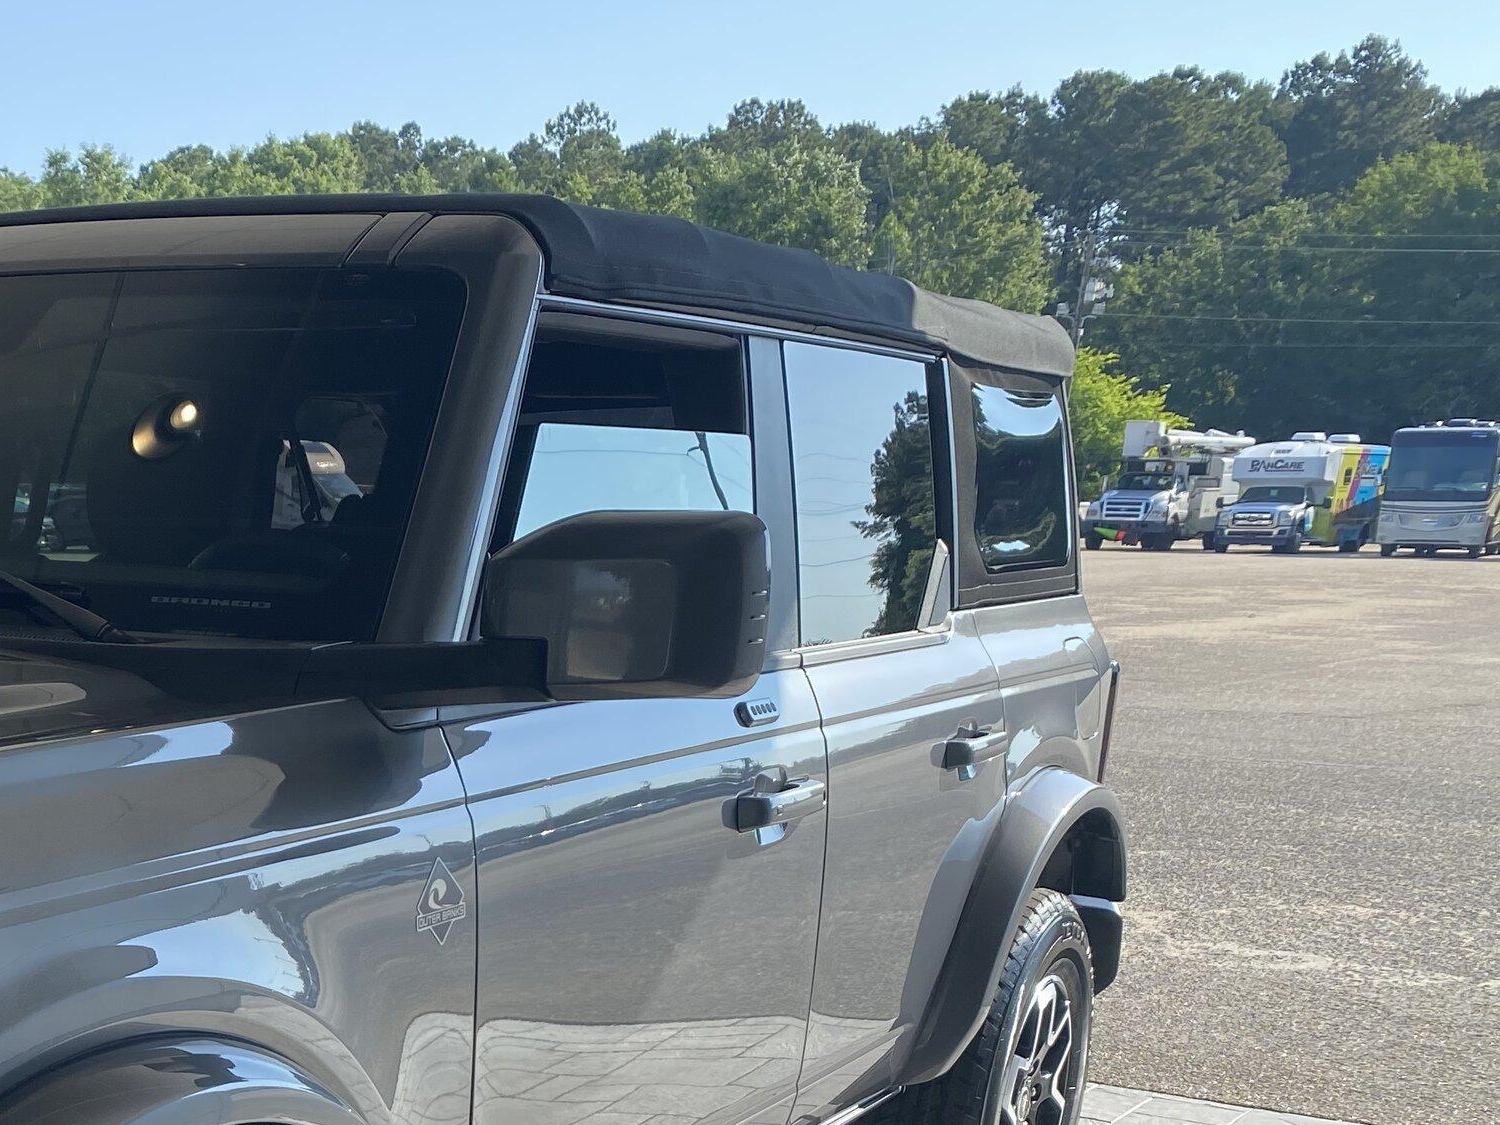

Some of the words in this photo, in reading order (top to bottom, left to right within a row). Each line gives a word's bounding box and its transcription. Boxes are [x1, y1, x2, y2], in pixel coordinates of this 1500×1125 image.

[151, 596, 272, 609] BRONCO
[419, 913, 441, 928] OUTER
[442, 906, 464, 921] BANKS
